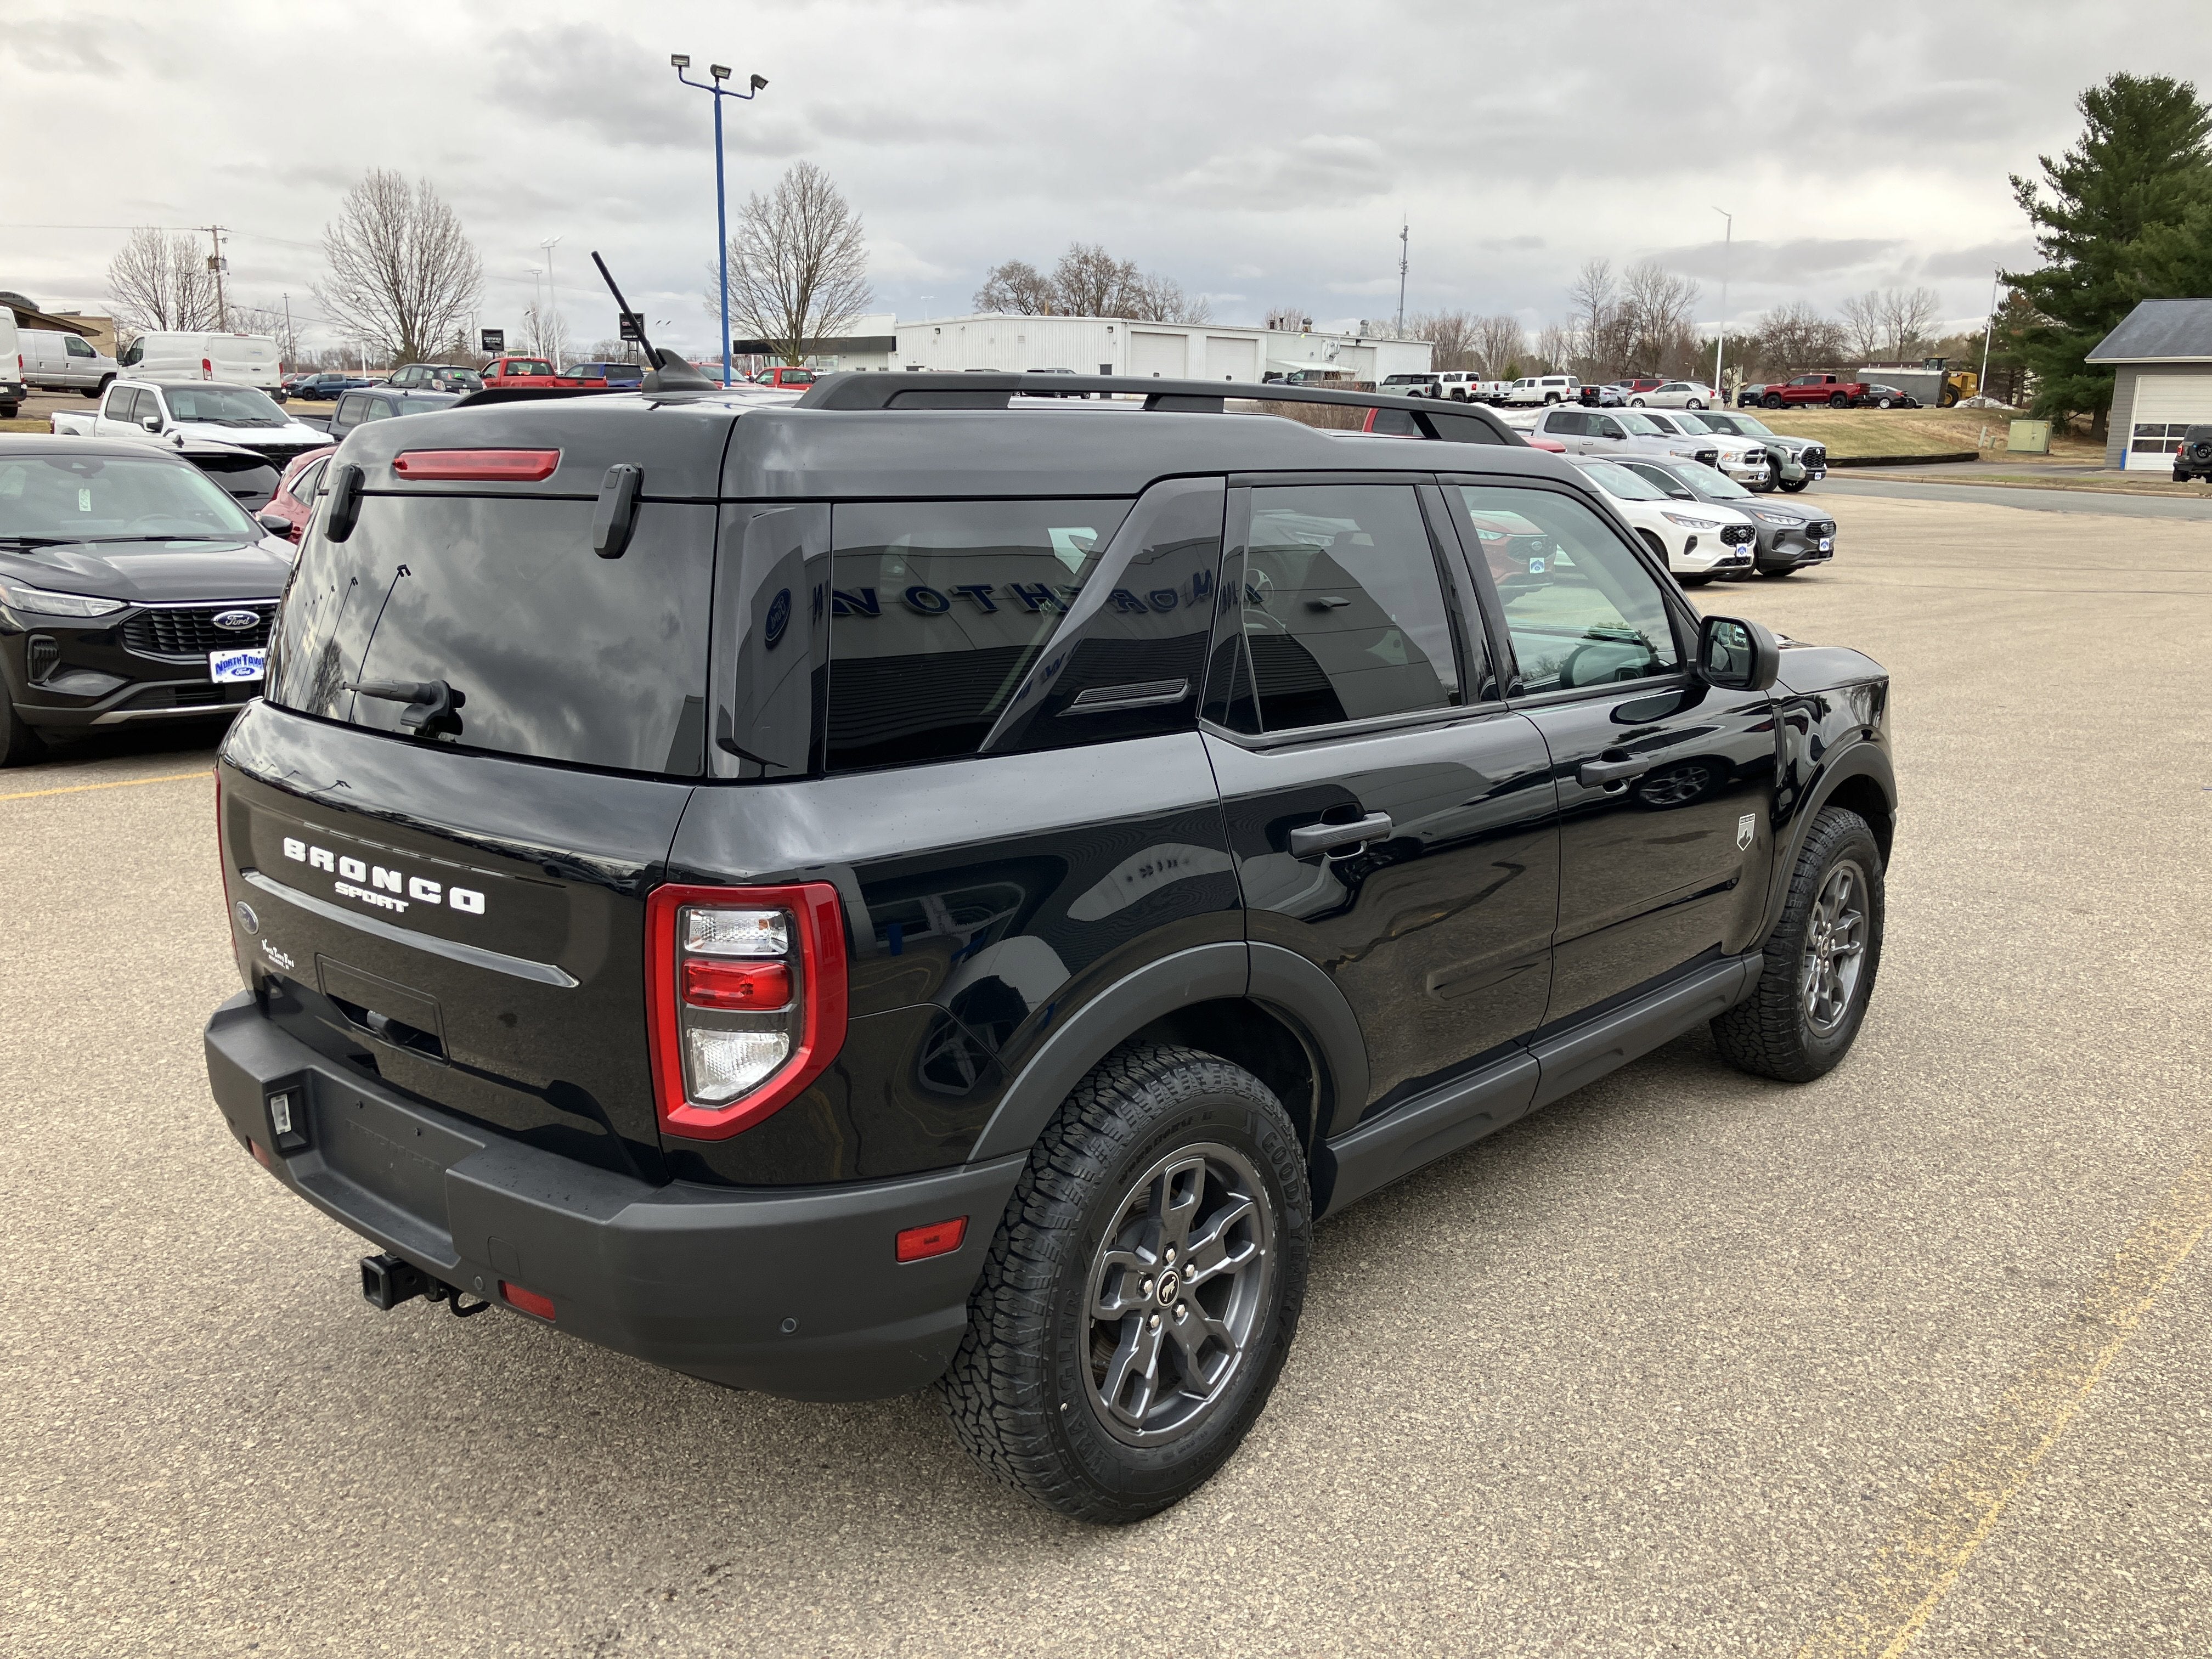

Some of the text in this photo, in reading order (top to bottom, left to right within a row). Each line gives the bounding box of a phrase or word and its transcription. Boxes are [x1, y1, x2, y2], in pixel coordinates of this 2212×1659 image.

[225, 614, 250, 627] Ford
[215, 656, 242, 675] NORTH
[284, 837, 486, 915] BRONCO
[335, 881, 409, 913] SPORT
[1058, 1289, 1107, 1480] WRANGLER
